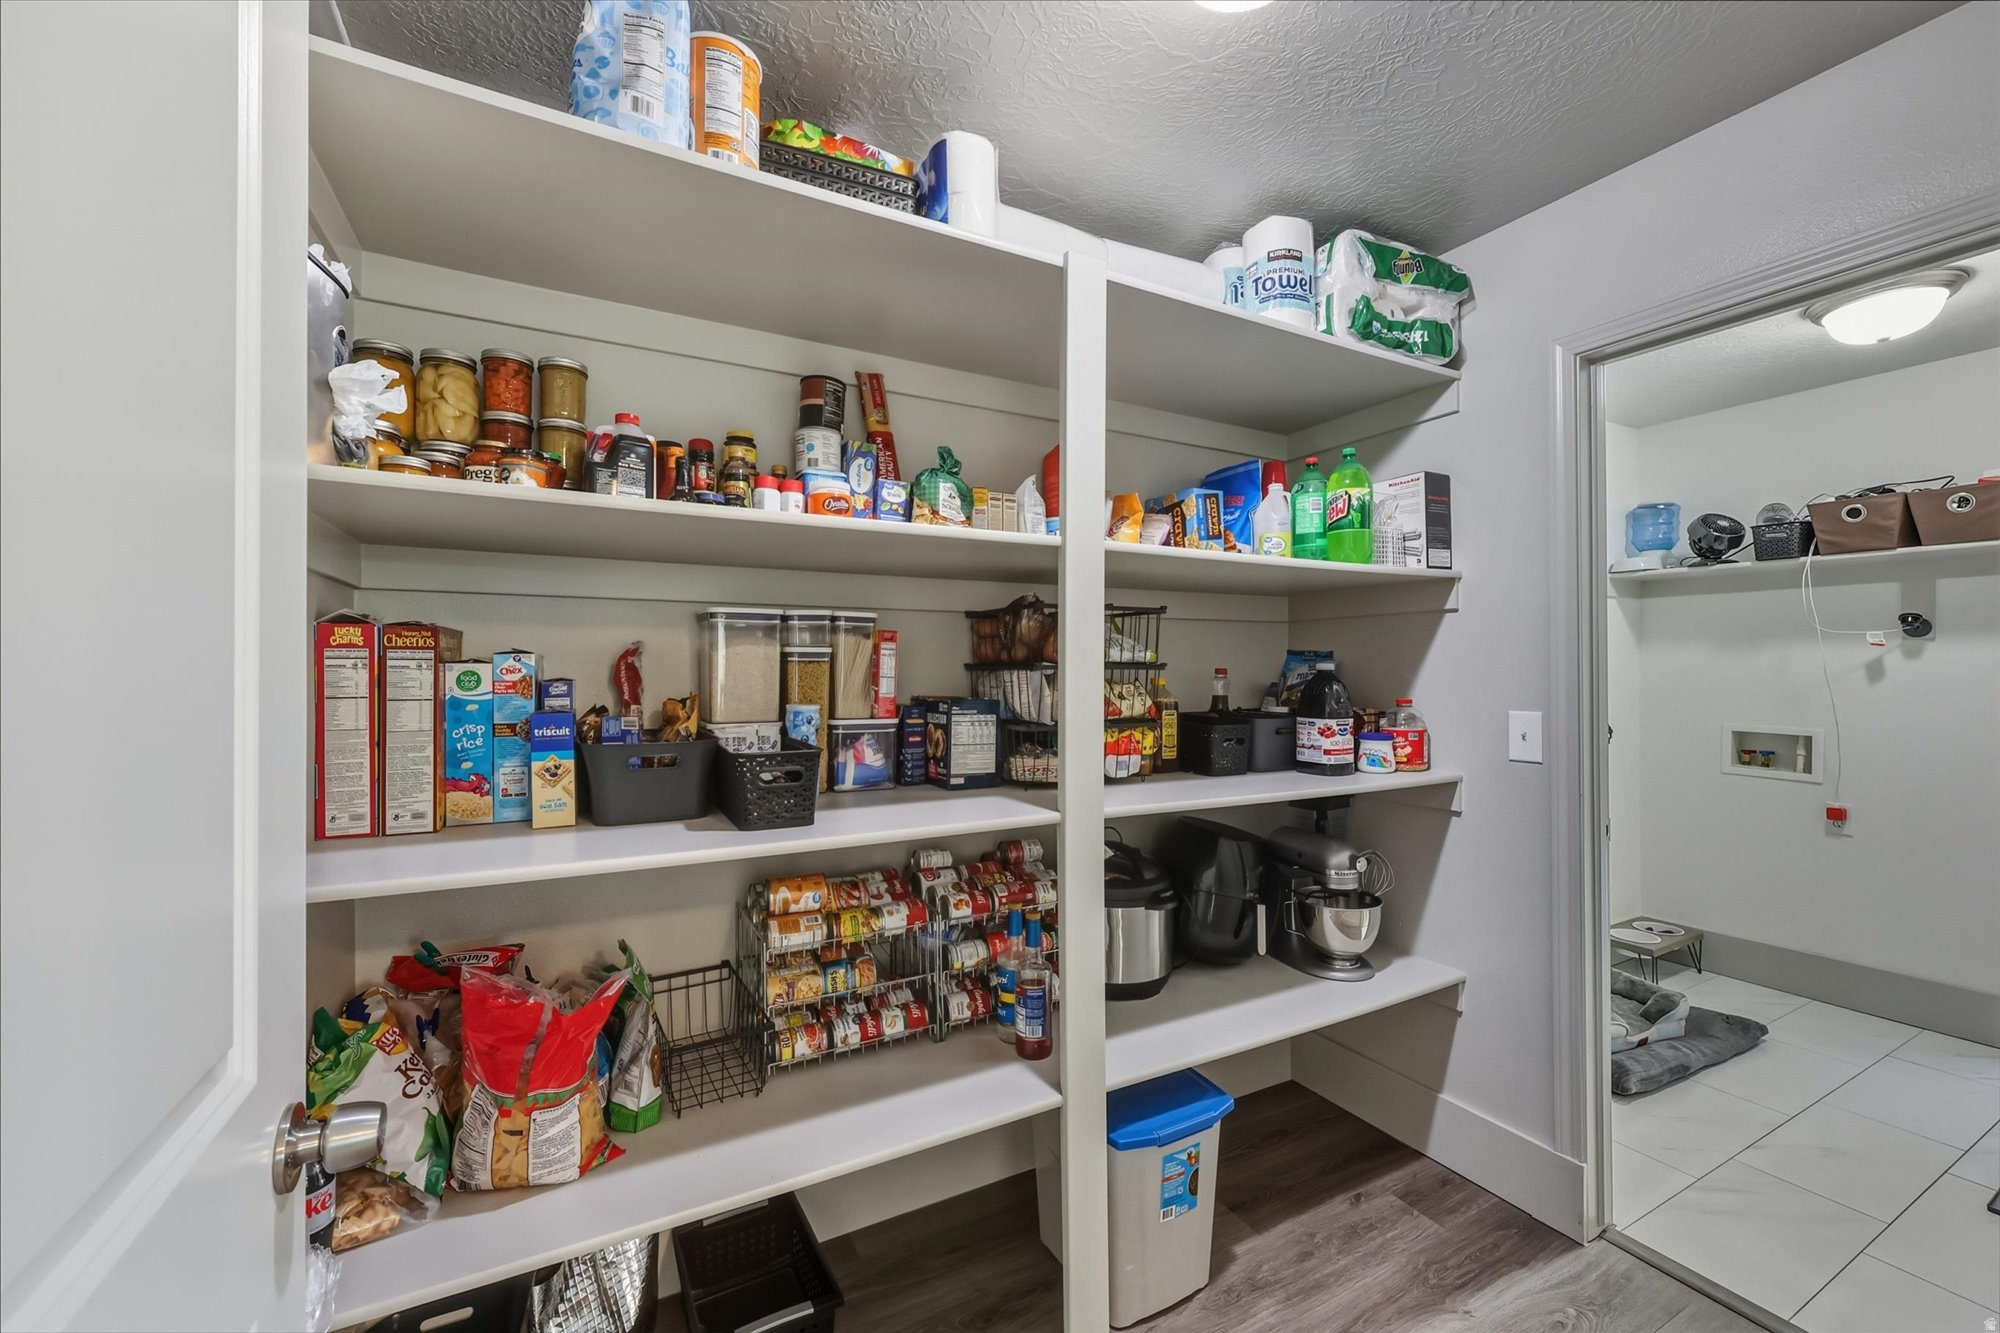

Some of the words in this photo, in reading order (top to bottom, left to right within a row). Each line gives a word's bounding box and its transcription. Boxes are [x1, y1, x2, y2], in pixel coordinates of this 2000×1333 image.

[1266, 267, 1305, 275] PREMIUM
[1393, 259, 1423, 275] Bounty
[1252, 275, 1313, 297] Towel
[334, 627, 361, 637] Lucky
[330, 635, 364, 646] Charms
[384, 634, 435, 647] Cheerios
[499, 667, 523, 676] Chex
[461, 674, 478, 682] food
[452, 724, 485, 738] crisp
[534, 727, 571, 737] triscuit
[457, 737, 483, 751] rice
[306, 1192, 332, 1219] ke
